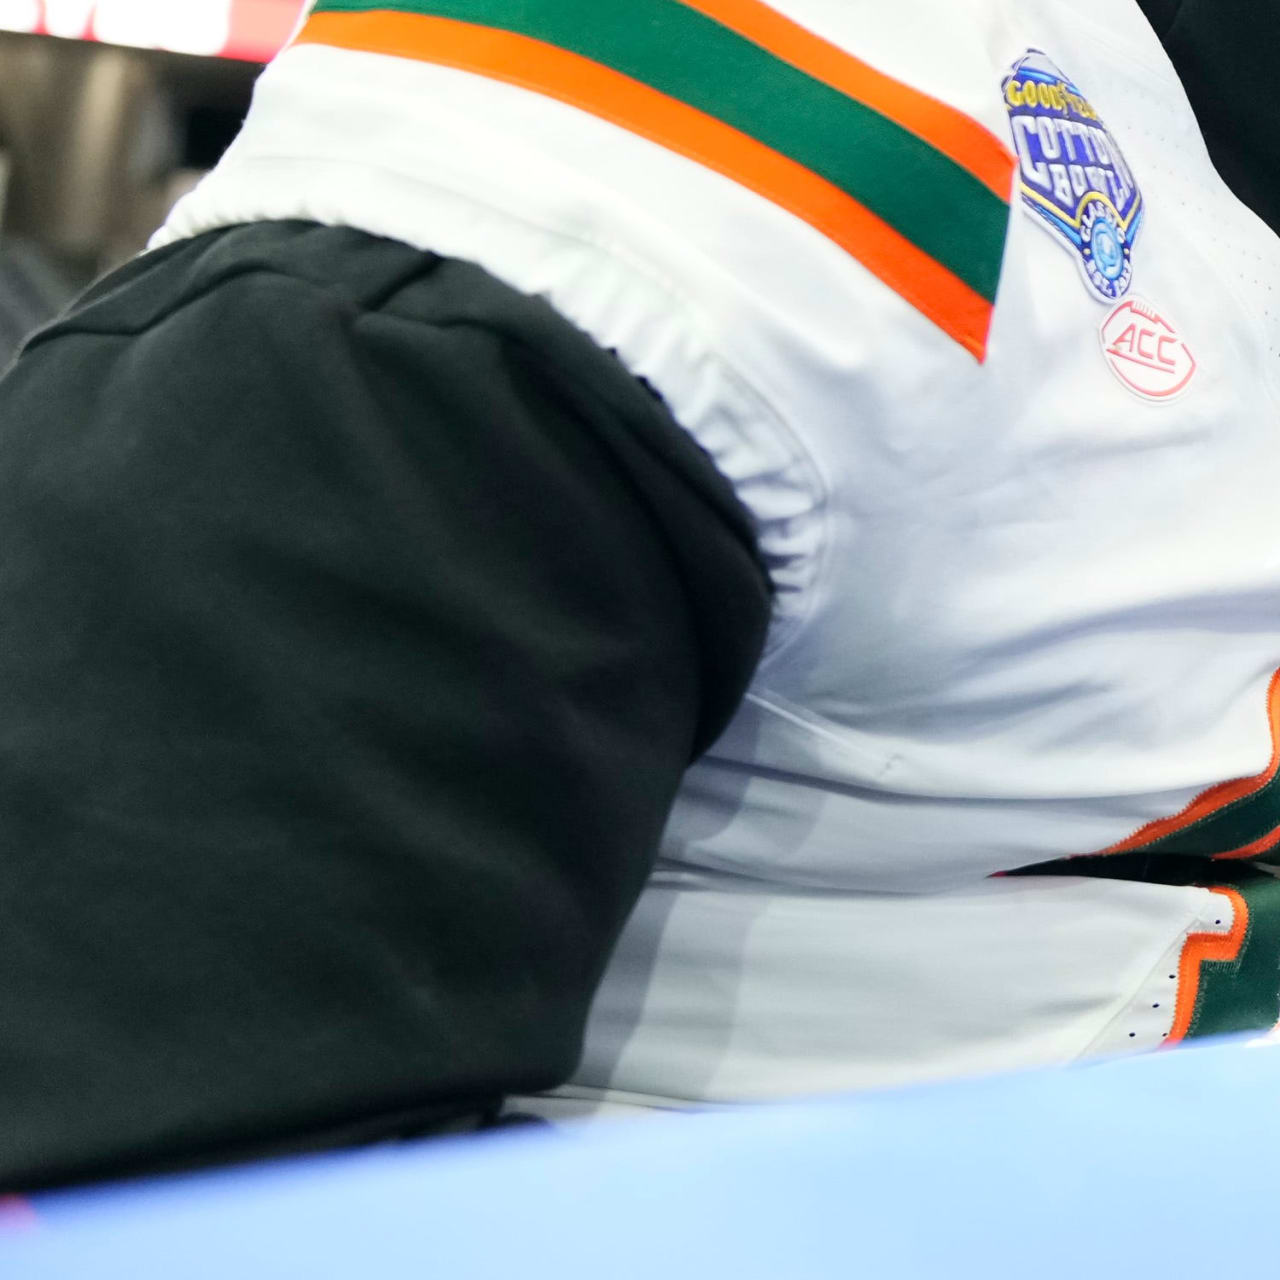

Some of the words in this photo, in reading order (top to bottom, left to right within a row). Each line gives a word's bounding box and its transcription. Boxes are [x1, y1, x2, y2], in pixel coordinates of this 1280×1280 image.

[1010, 114, 1135, 199] COTTON
[1048, 162, 1126, 212] BOWL
[1112, 322, 1177, 366] ACC
